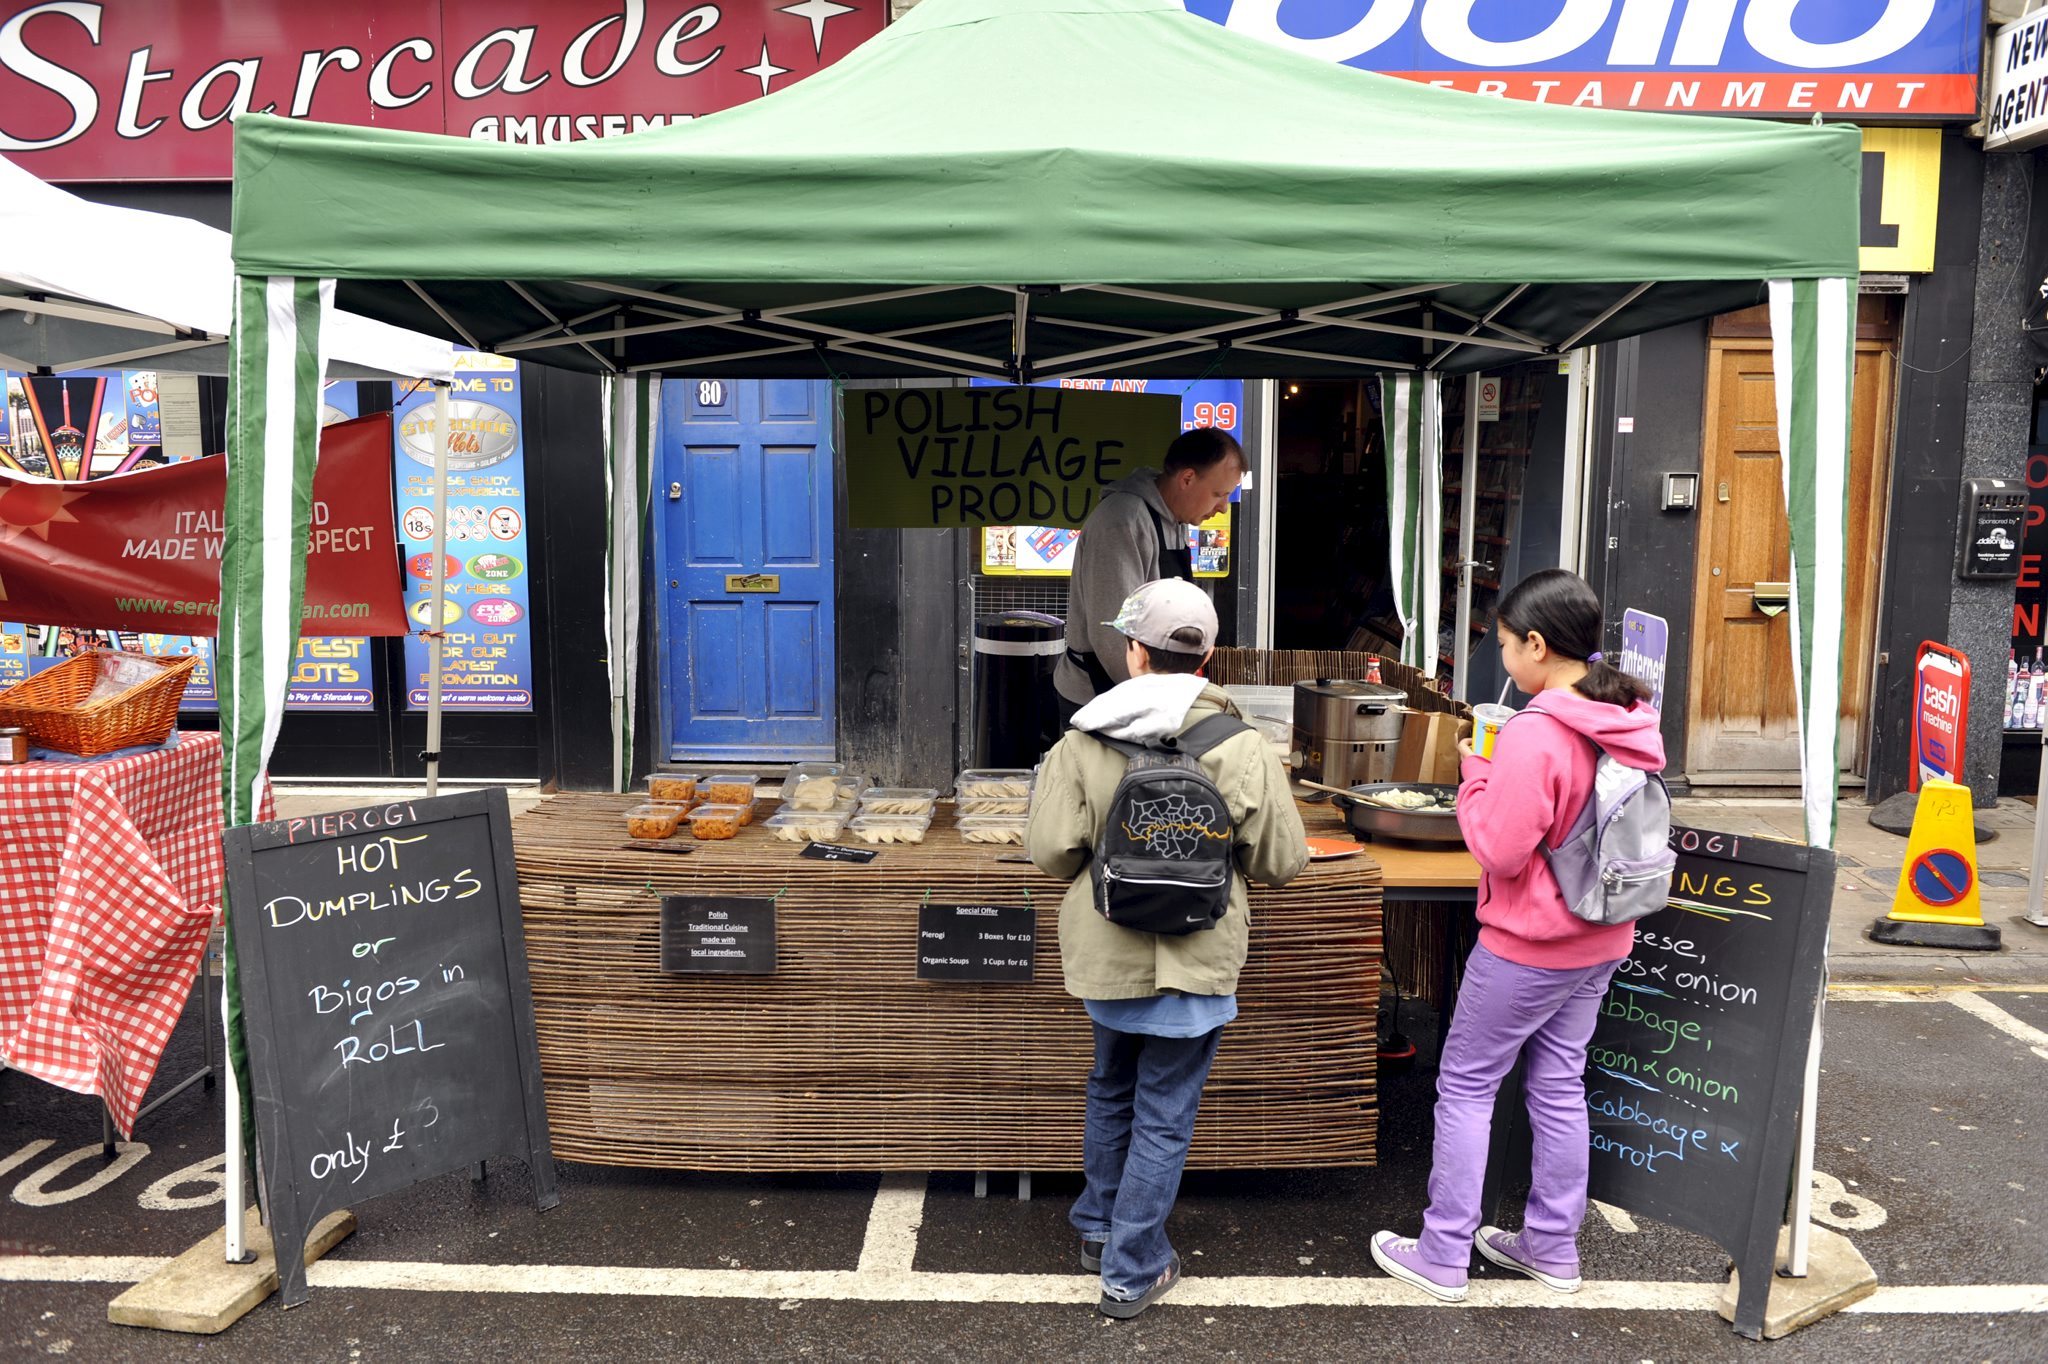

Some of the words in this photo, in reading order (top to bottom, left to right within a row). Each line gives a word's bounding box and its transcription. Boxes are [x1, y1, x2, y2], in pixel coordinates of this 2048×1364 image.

[0, 0, 726, 151] Starcade
[396, 378, 486, 392] WELOME
[490, 378, 514, 392] TO
[700, 380, 721, 405] 80
[864, 387, 1063, 435] POLISH
[1184, 402, 1237, 431] .99
[897, 435, 1124, 485] VILLAGE
[471, 476, 512, 486] ENJOY
[931, 480, 1092, 525] PRODU
[407, 520, 432, 533] 18s
[121, 538, 196, 560] MADE
[419, 583, 461, 594] PAY
[466, 583, 512, 594] HERE
[419, 633, 475, 644] WTCH
[483, 633, 517, 644] OUT
[296, 637, 366, 658] TEST
[471, 647, 507, 658] OUR
[420, 674, 519, 685] POMOTION
[296, 693, 310, 703] Play
[414, 694, 428, 702] You
[1923, 683, 1957, 717] cash
[1923, 710, 1952, 734] machine
[337, 834, 429, 875] HOT
[708, 911, 728, 920] Polish
[956, 906, 980, 915] Special
[980, 907, 998, 916] Offer
[688, 923, 723, 932] Traditional
[724, 923, 749, 932] Cuisine
[701, 937, 720, 945] made
[721, 937, 736, 945] with
[921, 931, 945, 940] Pierogi
[978, 932, 983, 940] 3
[984, 932, 1004, 941] Boxes
[1006, 933, 1017, 941] for
[1018, 934, 1031, 942] £10
[352, 937, 396, 958] or
[691, 948, 706, 957] local
[707, 948, 747, 958] ingredients.
[922, 956, 948, 965] Organic
[949, 957, 969, 966] Soups
[983, 957, 988, 965] 3
[988, 957, 1005, 967] Cups
[1007, 958, 1018, 966] for
[1019, 959, 1028, 967] £6
[308, 977, 420, 1026] Bigos
[440, 962, 464, 983] in
[1675, 972, 1757, 1005] onion
[1666, 1067, 1739, 1104] onion
[310, 1132, 371, 1184] only
